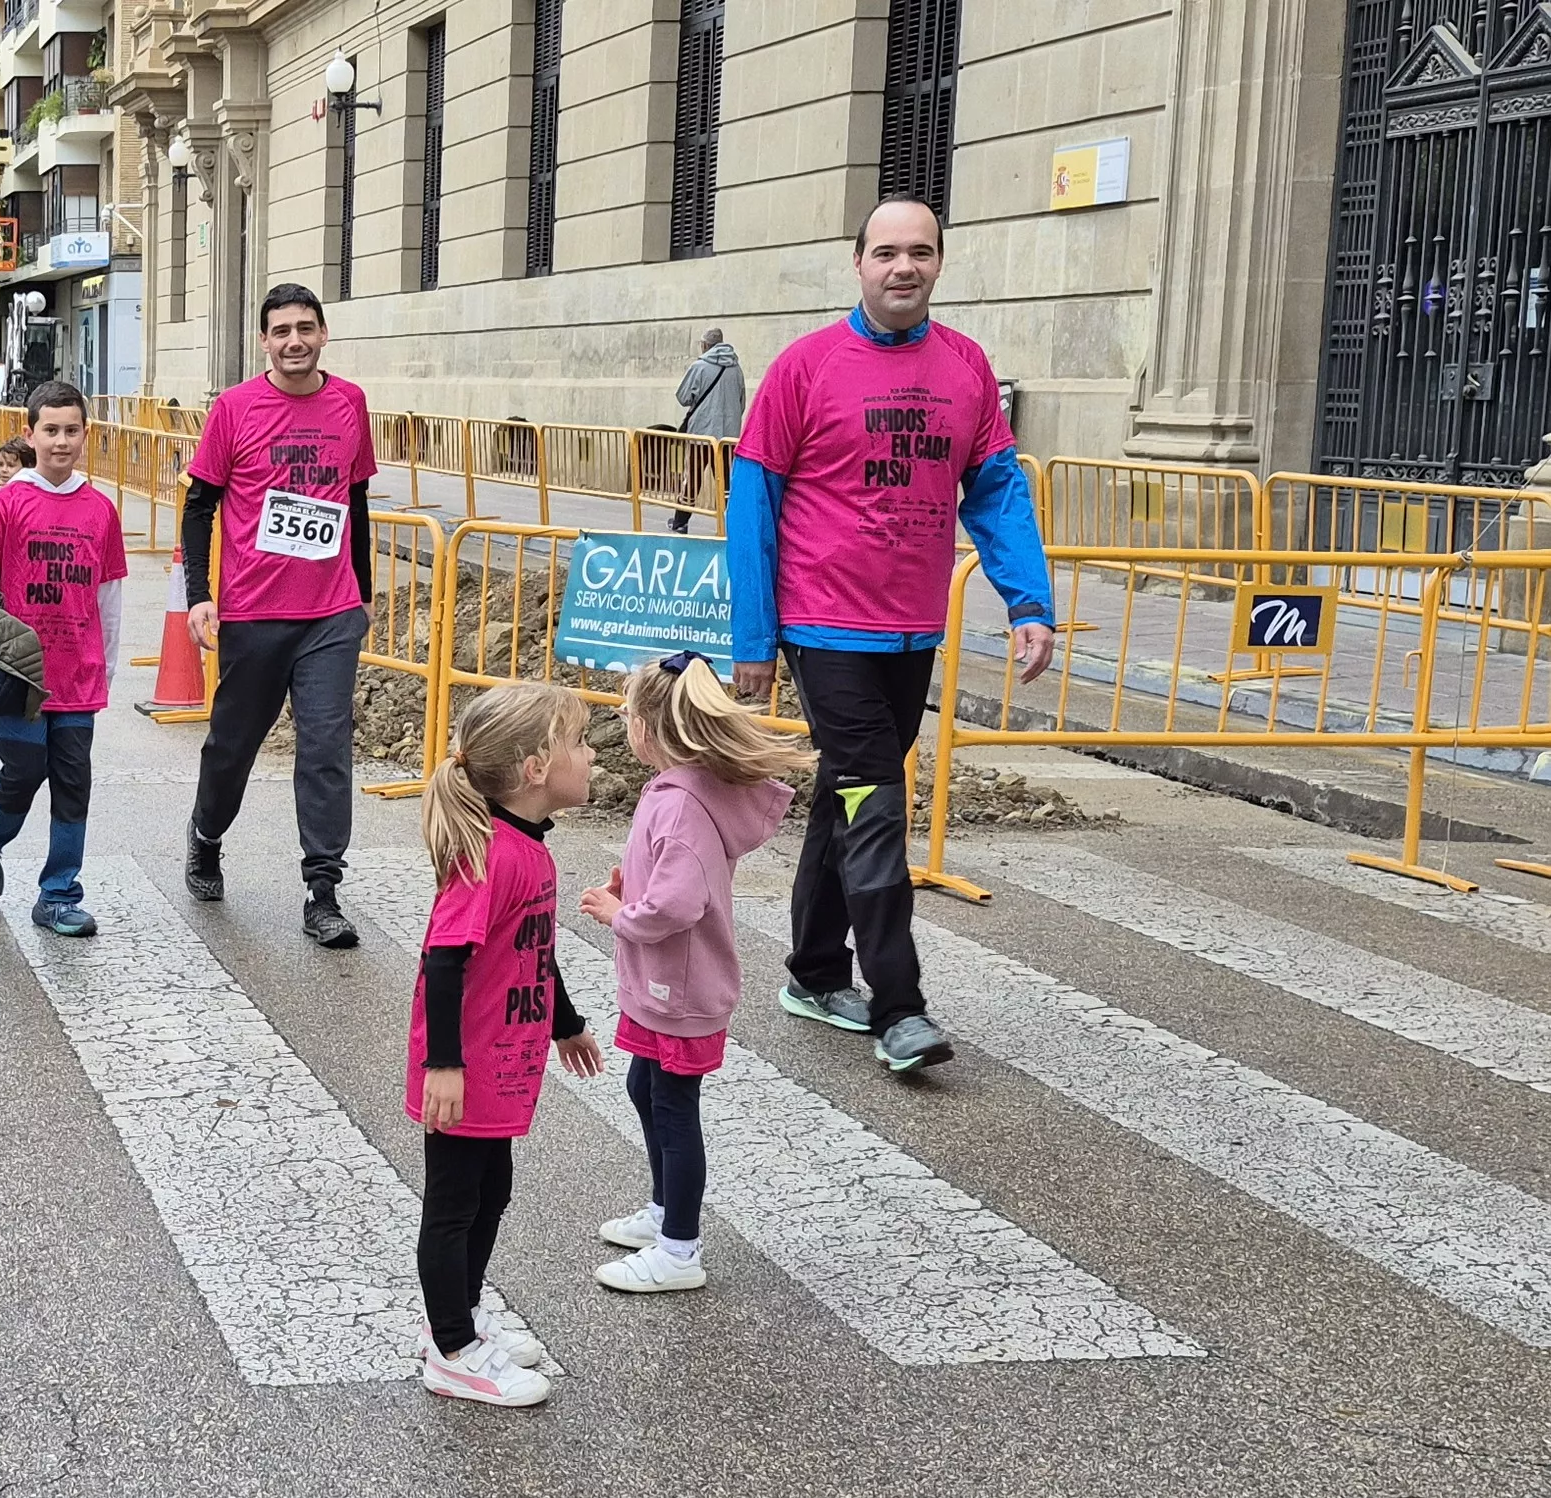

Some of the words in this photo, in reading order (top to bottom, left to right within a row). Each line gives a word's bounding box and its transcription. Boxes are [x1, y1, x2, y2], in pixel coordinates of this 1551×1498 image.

[865, 408, 926, 433] UNIDOS
[270, 444, 318, 464] UNIDOS
[892, 434, 912, 458] EN
[914, 434, 952, 461] CADA
[290, 466, 306, 484] EN
[308, 466, 339, 486] CADA
[864, 460, 911, 488] PASO
[274, 502, 301, 513] CONTRA
[268, 513, 334, 544] 3560
[47, 562, 63, 582] EN
[26, 583, 64, 604] PASO
[574, 590, 645, 613] SERVICIOS
[648, 598, 731, 620] INMOBILIARI
[570, 616, 733, 645] www.garlaninmobiliaria.co
[505, 985, 548, 1025] PAS
